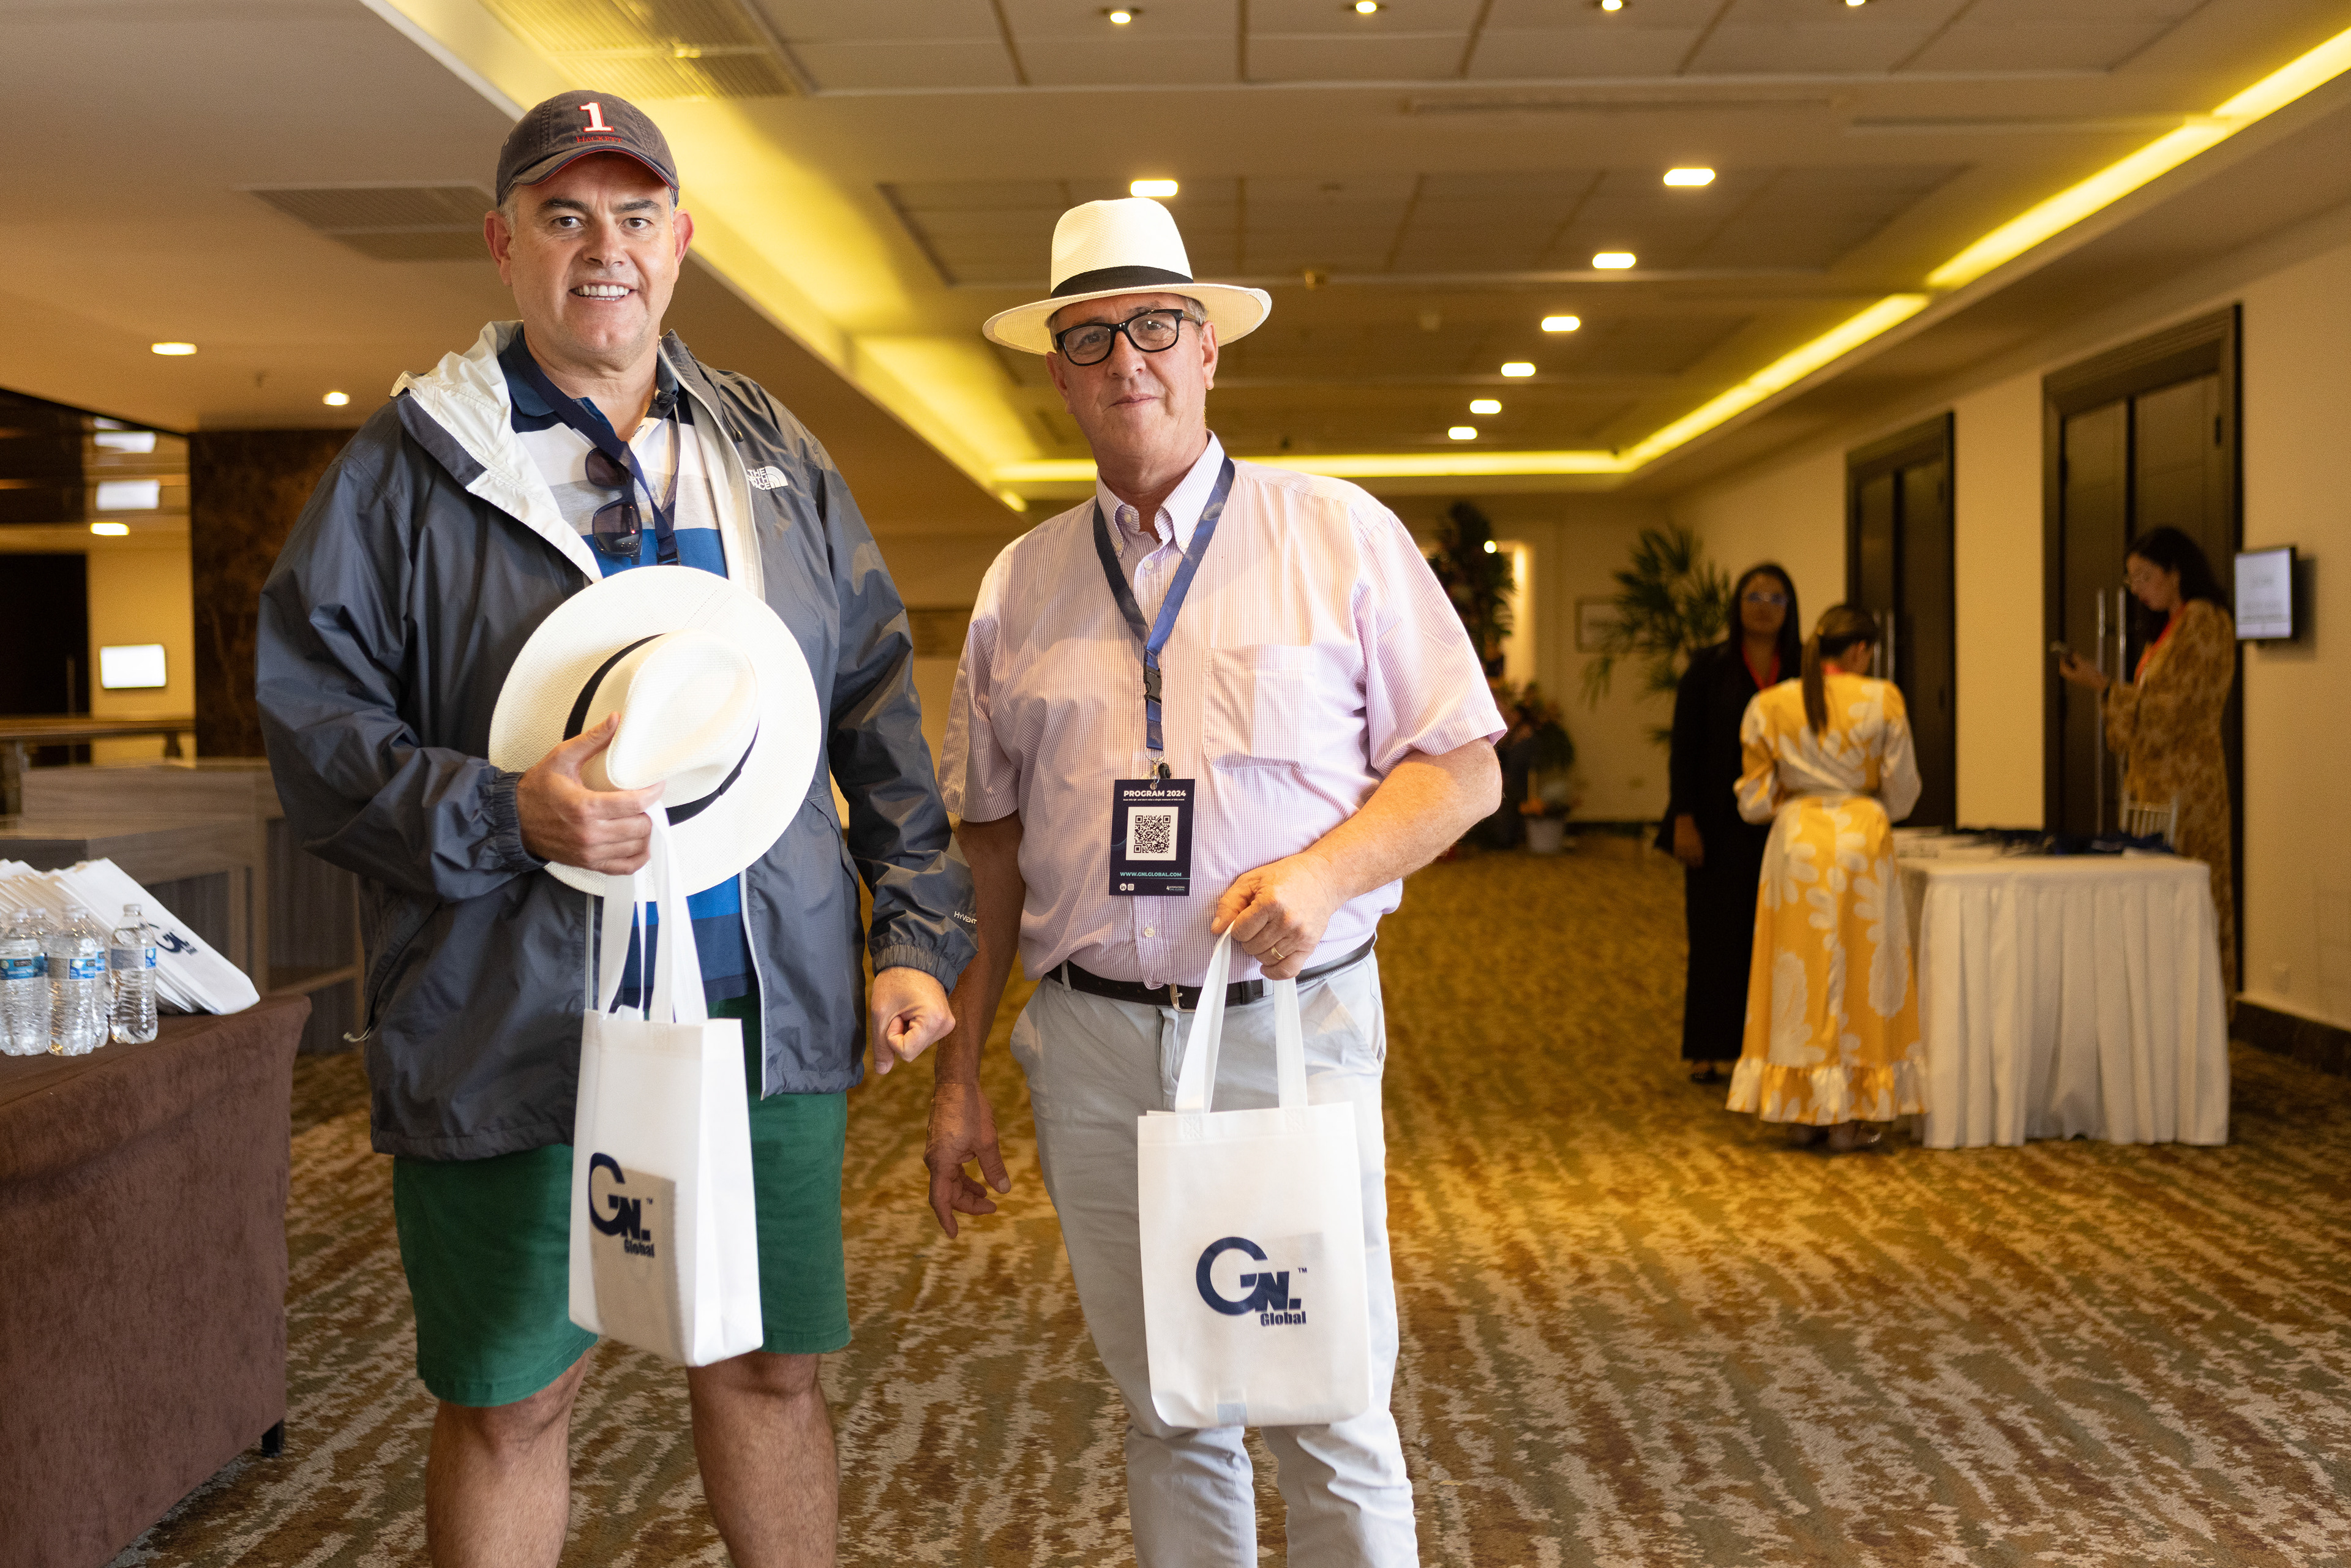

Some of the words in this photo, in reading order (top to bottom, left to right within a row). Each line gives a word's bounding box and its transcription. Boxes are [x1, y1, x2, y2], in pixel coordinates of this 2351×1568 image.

[579, 102, 614, 132] 1
[747, 467, 766, 477] THE
[746, 475, 769, 484] ORTH
[751, 481, 771, 490] ACE
[954, 911, 977, 925] HYVENT
[624, 1239, 655, 1258] Global
[1260, 1311, 1307, 1327] Global
